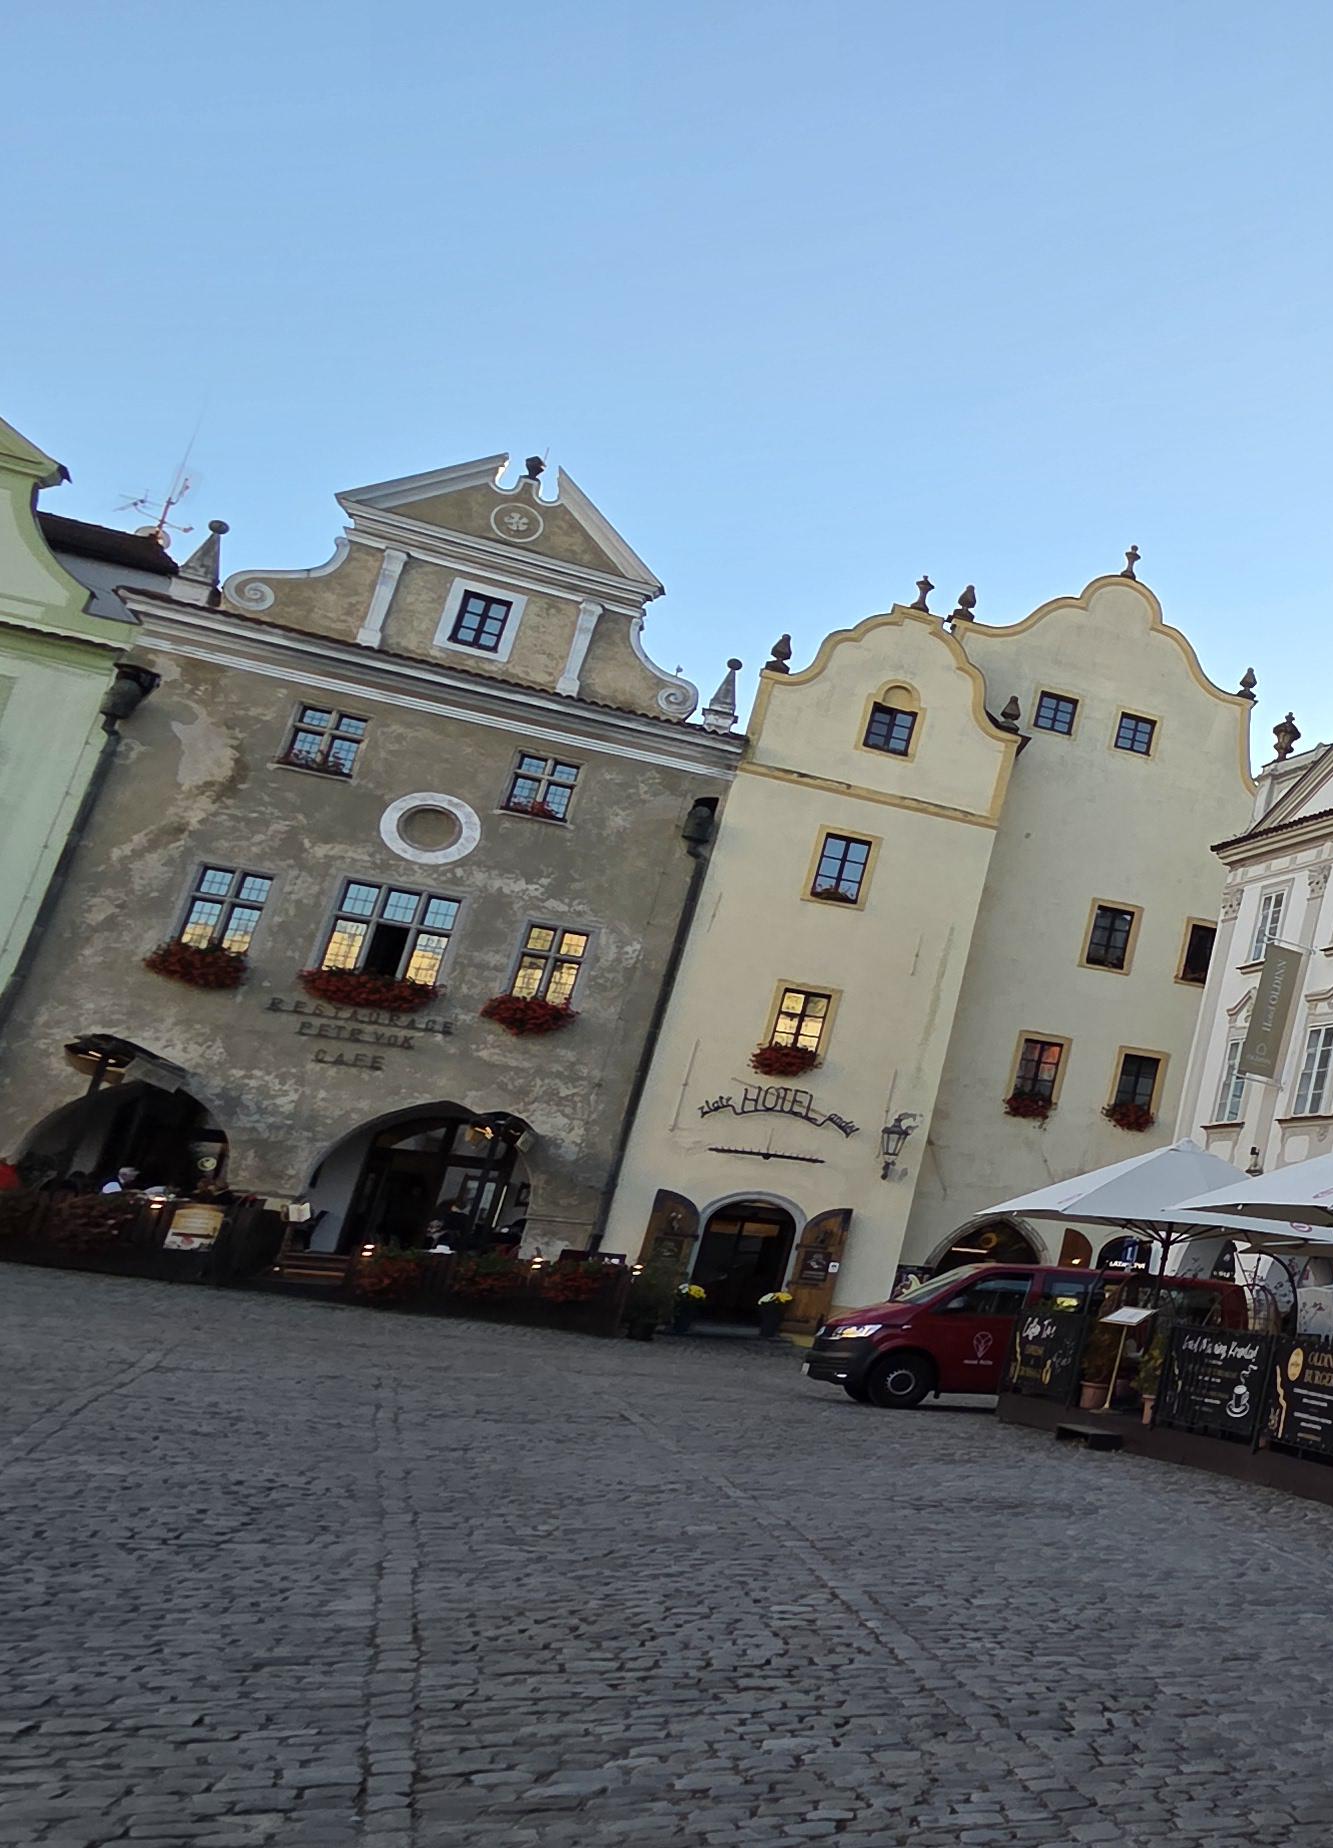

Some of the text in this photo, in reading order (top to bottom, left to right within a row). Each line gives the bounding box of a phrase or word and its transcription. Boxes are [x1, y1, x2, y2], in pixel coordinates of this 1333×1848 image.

[1270, 959, 1288, 1005] OLDINN
[267, 996, 455, 1035] RESTAURACE
[297, 1020, 415, 1050] PETR VOK
[741, 1085, 819, 1123] HOTEL
